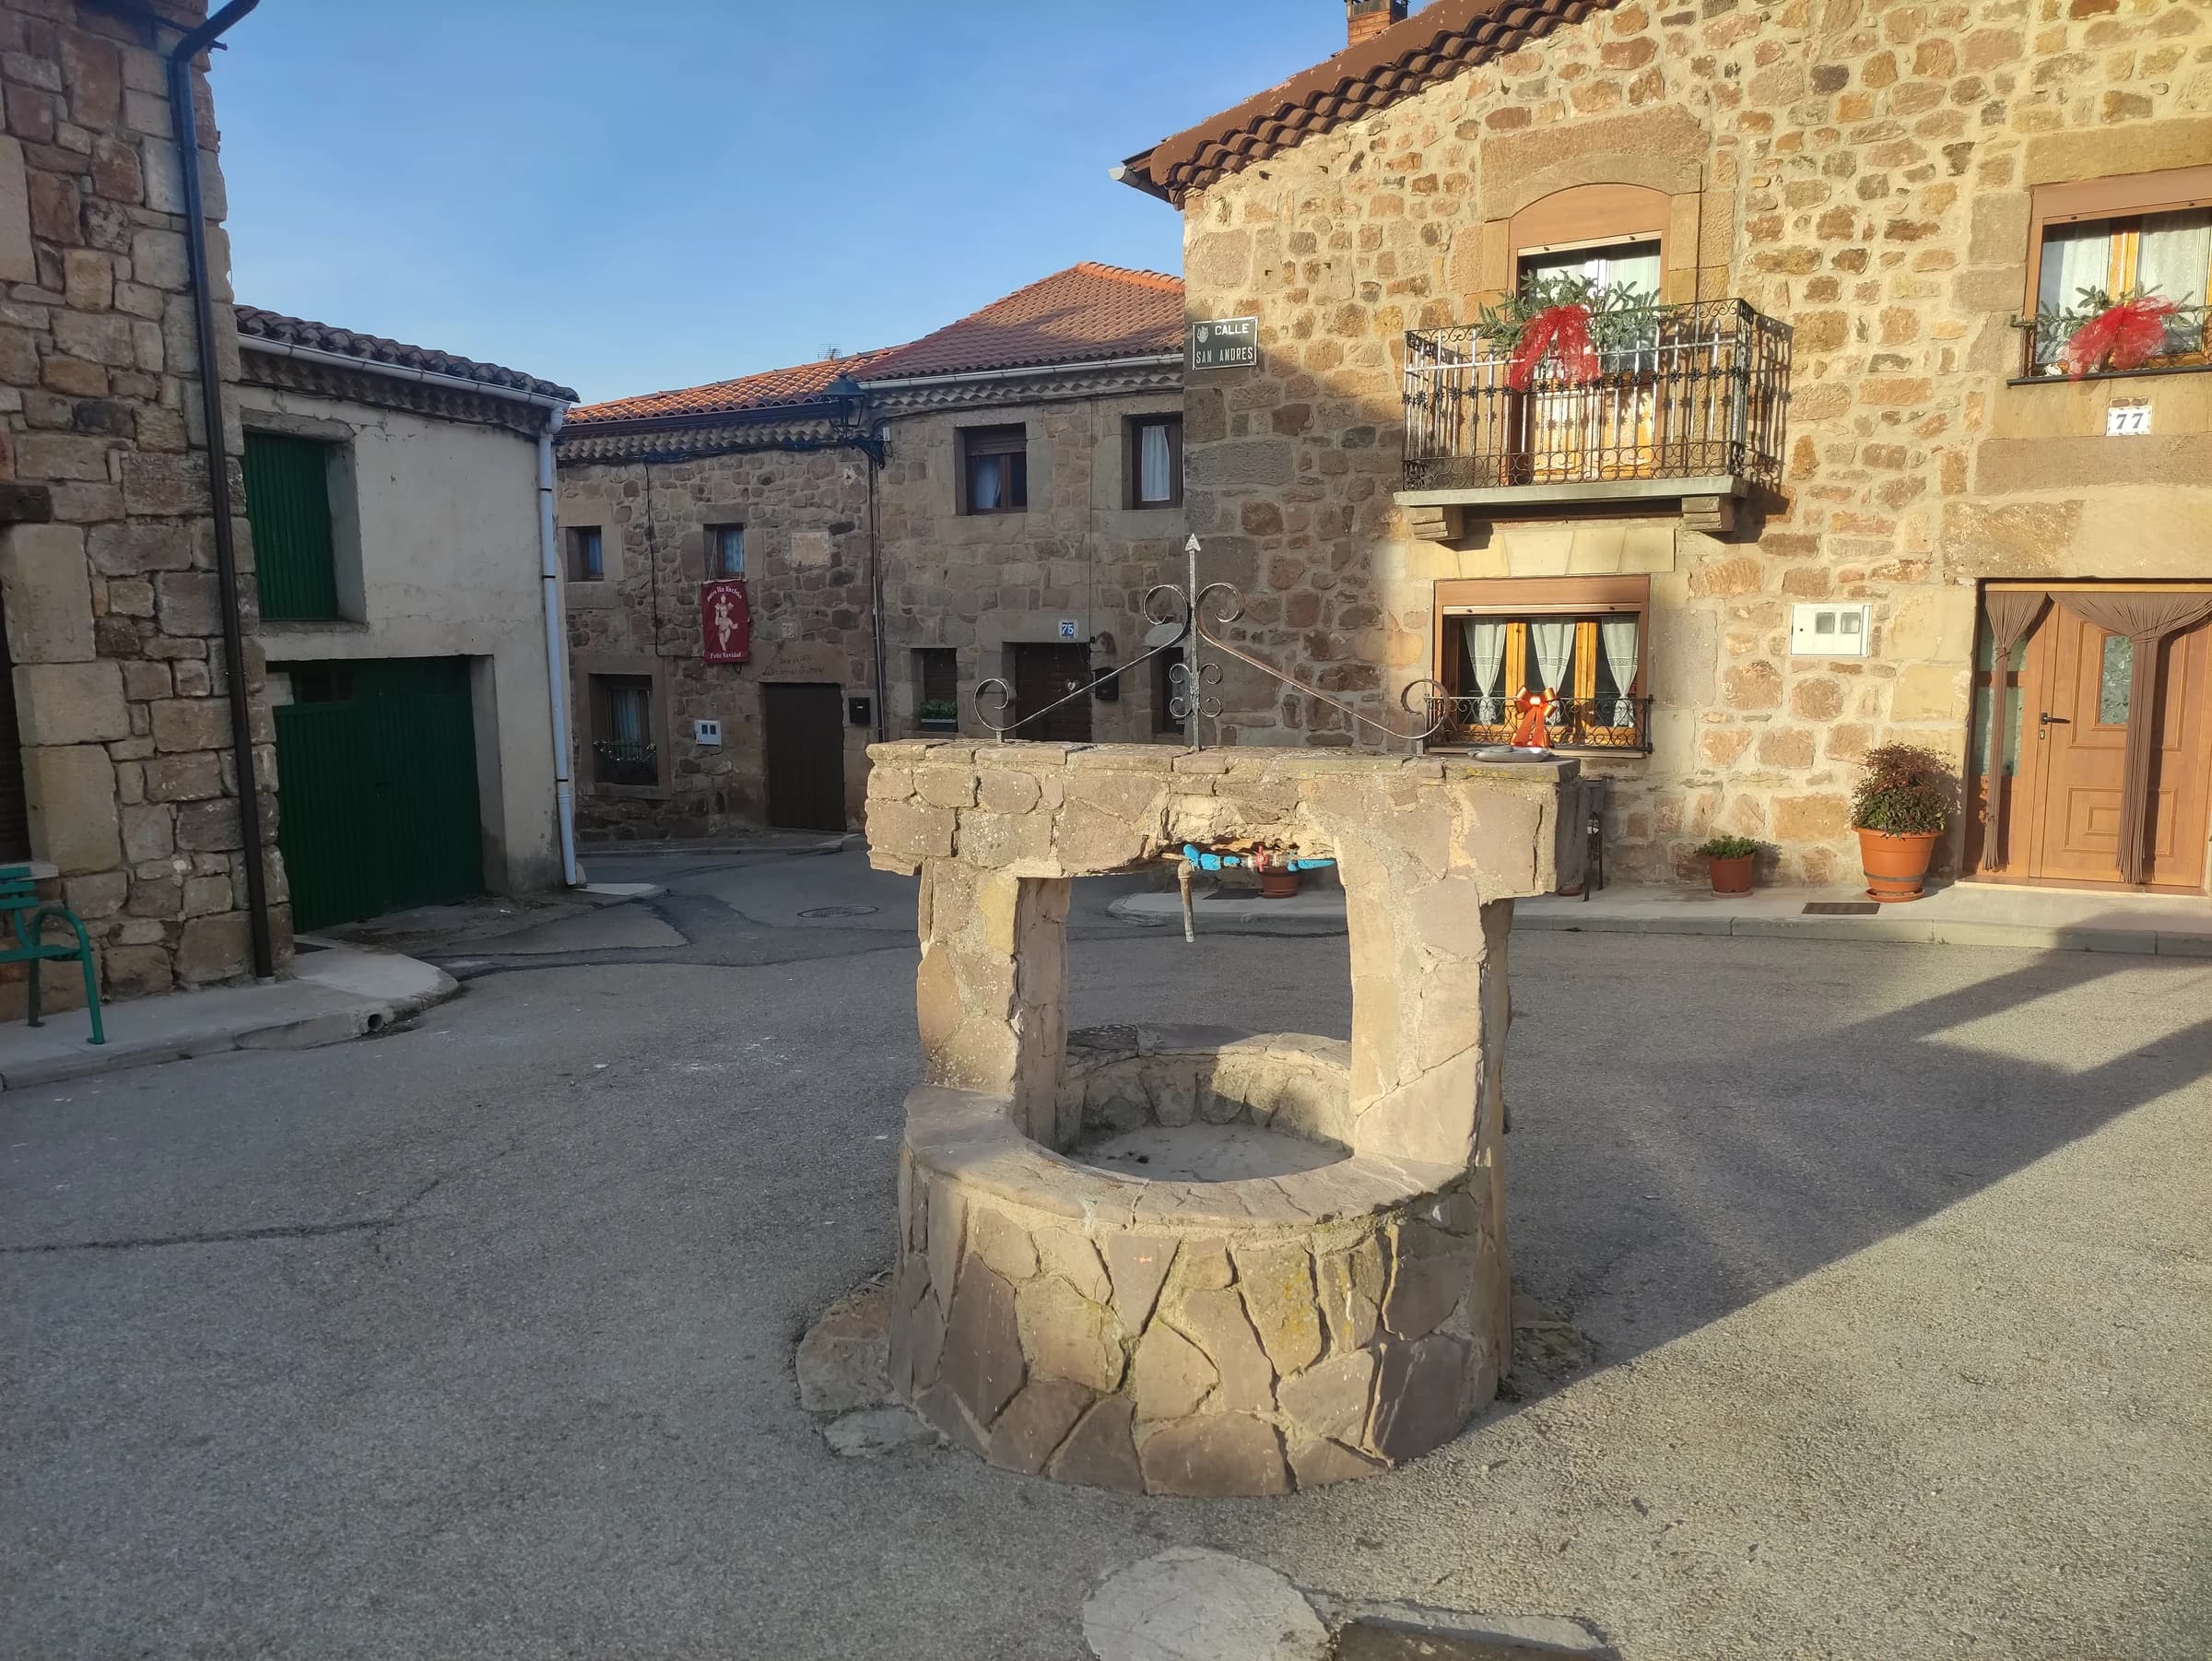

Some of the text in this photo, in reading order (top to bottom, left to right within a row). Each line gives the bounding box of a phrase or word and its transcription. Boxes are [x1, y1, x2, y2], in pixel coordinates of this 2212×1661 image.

[1215, 324, 1250, 336] CALLE
[1195, 347, 1253, 364] SAN ANDRES
[2116, 412, 2144, 430] 77
[1062, 624, 1074, 635] 75
